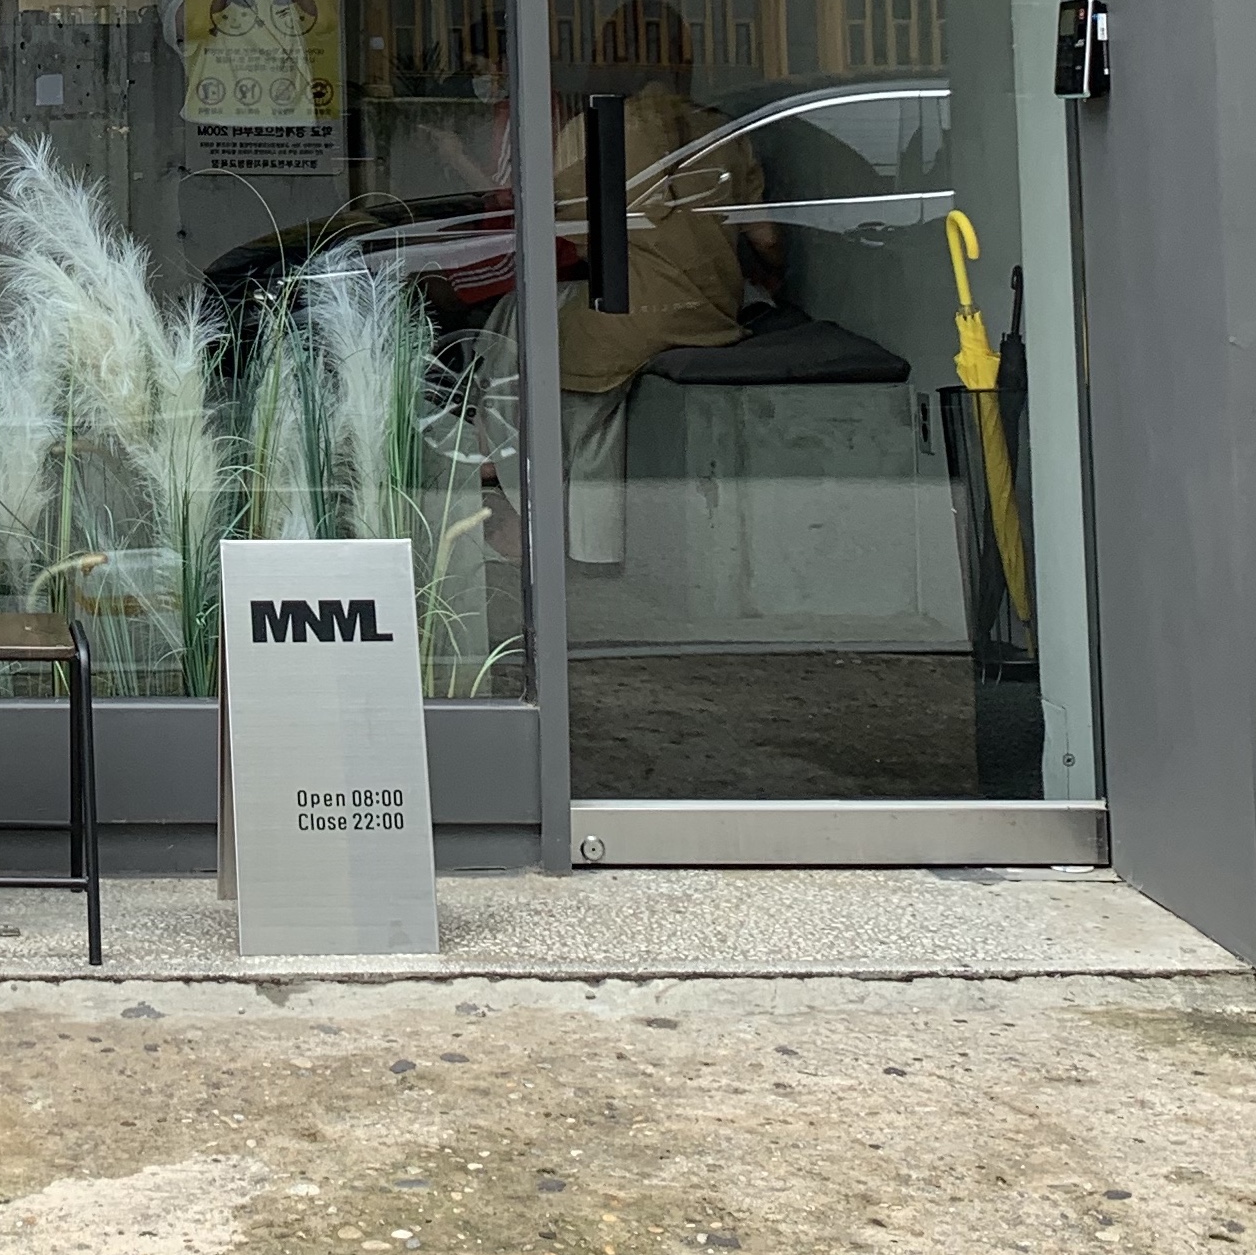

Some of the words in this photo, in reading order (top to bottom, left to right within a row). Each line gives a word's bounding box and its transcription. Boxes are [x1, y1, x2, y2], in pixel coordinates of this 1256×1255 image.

[250, 599, 394, 643] MNML
[297, 789, 346, 808] Open
[352, 789, 403, 807] 08:00
[298, 813, 347, 831] Close
[352, 812, 404, 830] 22:00
